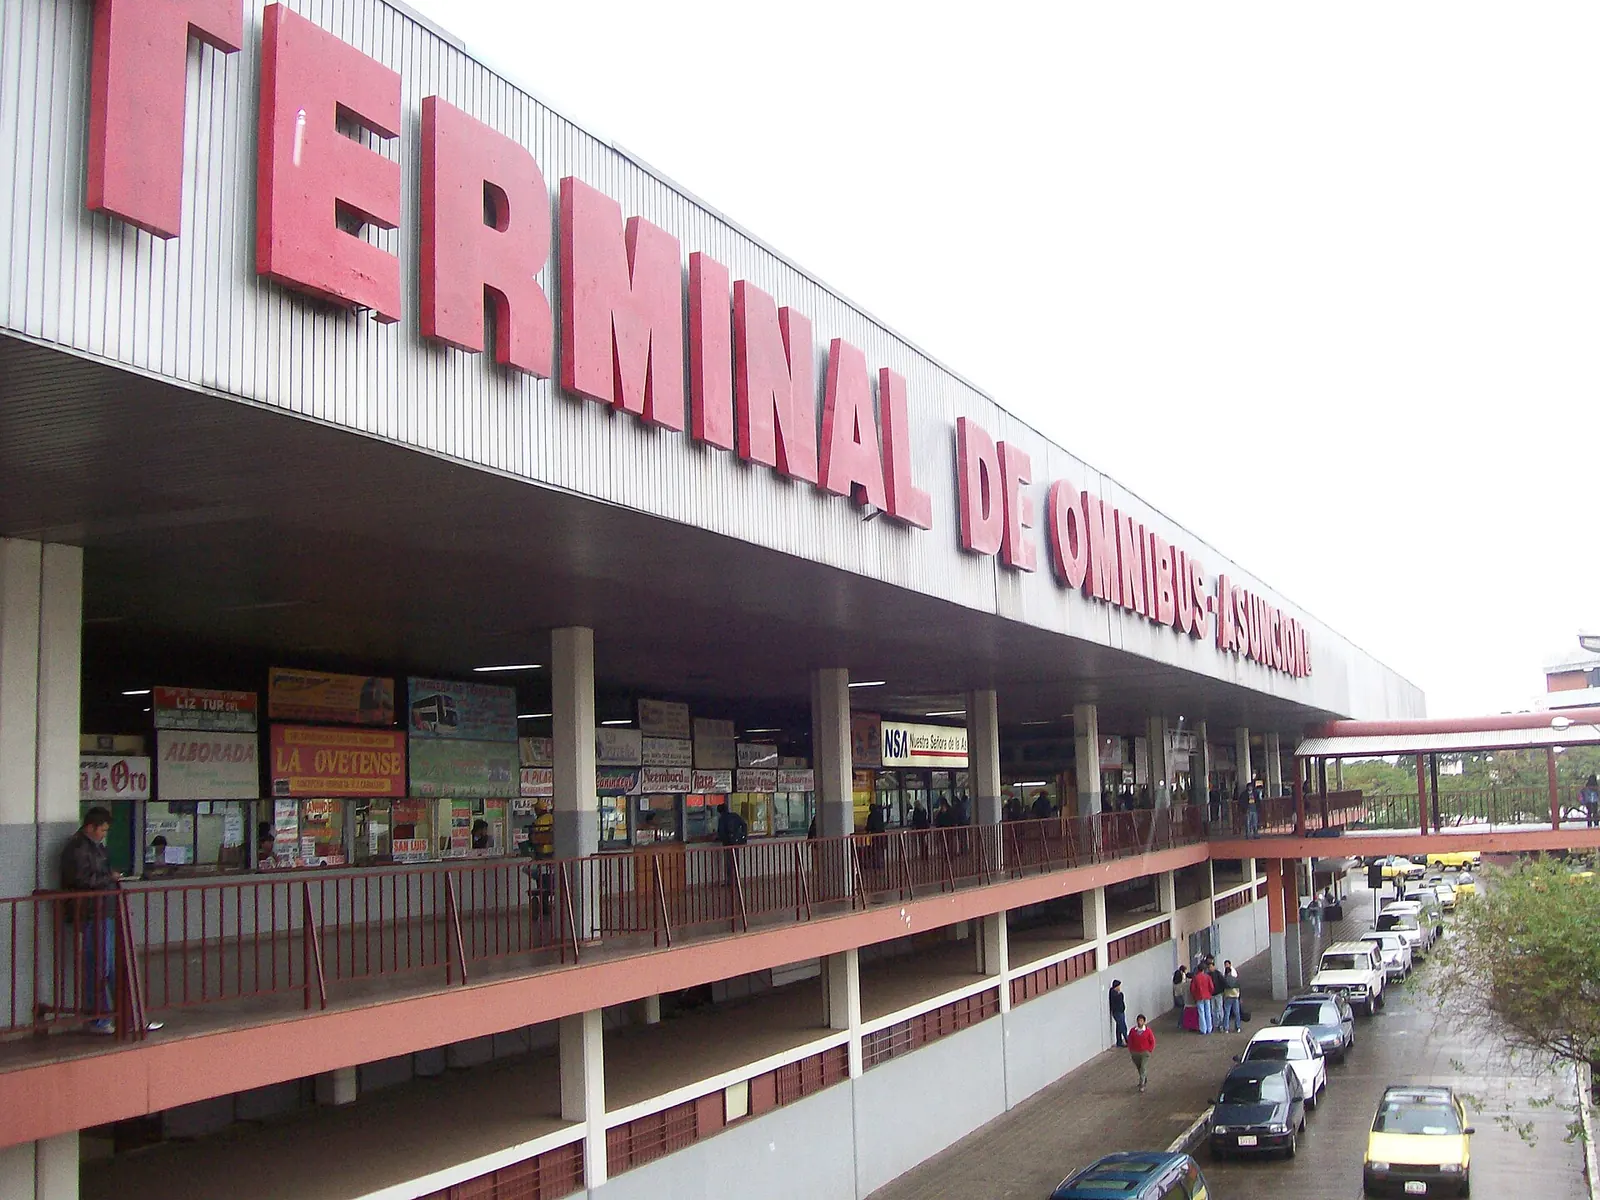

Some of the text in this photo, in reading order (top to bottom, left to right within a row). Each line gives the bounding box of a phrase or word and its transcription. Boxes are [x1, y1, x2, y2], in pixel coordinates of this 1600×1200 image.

[86, 0, 932, 530] TERMINAL
[957, 416, 1037, 573] DE
[176, 697, 197, 710] LIZ
[201, 698, 225, 711] TUR
[164, 742, 255, 764] ALBORADA
[884, 729, 908, 758] NSA
[909, 733, 929, 750] Nuestra
[930, 734, 947, 750] Señora
[948, 738, 954, 750] de
[955, 737, 960, 750] la
[276, 748, 301, 772] LA
[314, 749, 401, 774] OVETENSE
[93, 771, 108, 791] de
[111, 760, 147, 793] Oro
[393, 840, 427, 852] SAN LUIS
